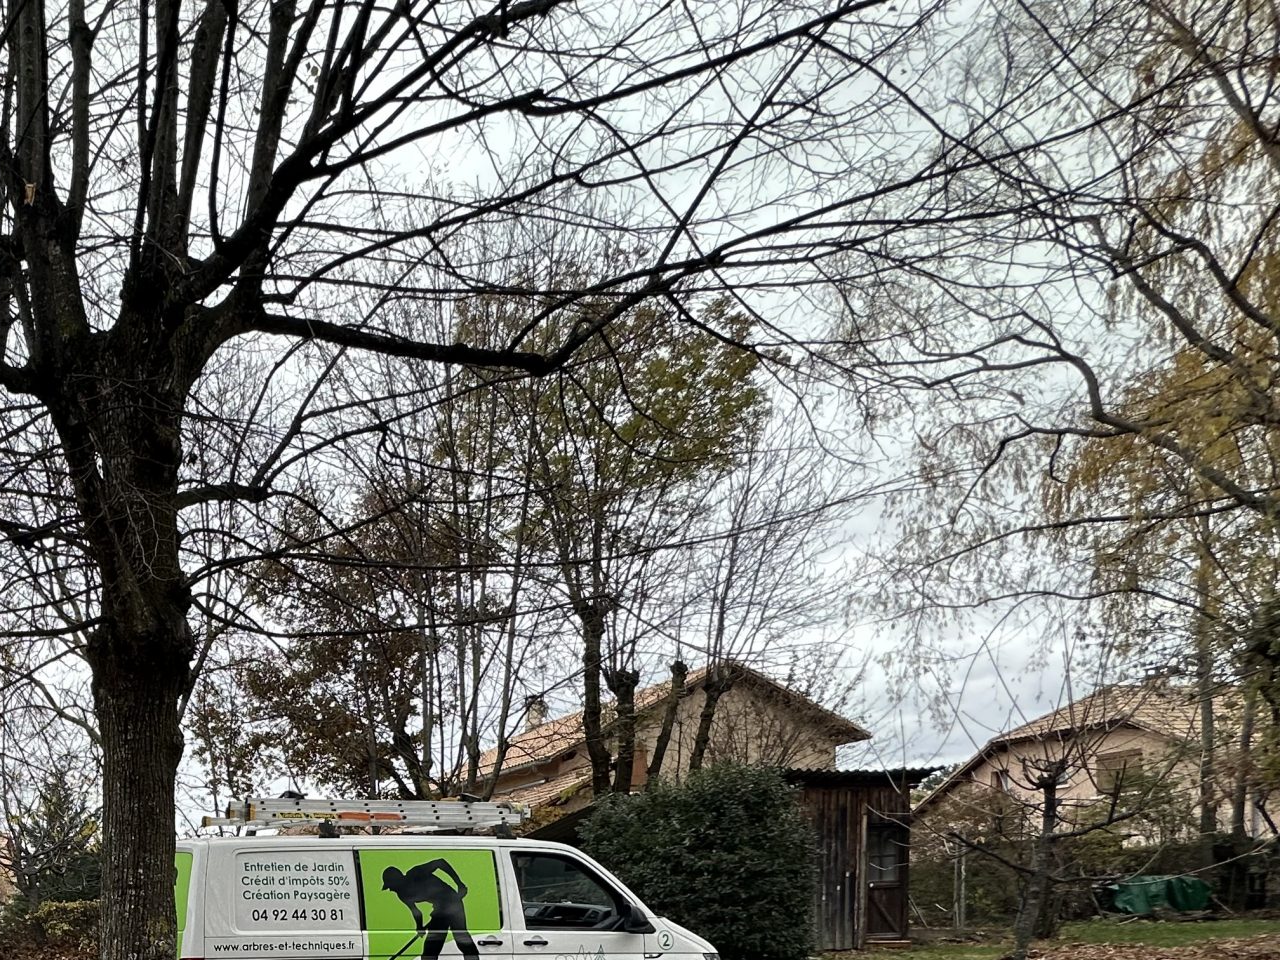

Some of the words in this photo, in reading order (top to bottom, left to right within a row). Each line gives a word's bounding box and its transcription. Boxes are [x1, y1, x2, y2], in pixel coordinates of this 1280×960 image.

[244, 862, 291, 872] Entretien
[294, 862, 309, 872] de
[312, 862, 344, 872] Jardin
[241, 875, 275, 886] Crédit
[278, 875, 325, 888] d'impôts
[328, 876, 350, 886] 50%
[242, 889, 290, 900] Création
[293, 889, 351, 902] Paysagère
[252, 909, 268, 921] 04
[272, 909, 288, 921] 92
[291, 909, 308, 921] 44
[311, 909, 326, 921] 30
[330, 909, 344, 921] 81
[213, 940, 355, 952] www.arbres-et-techniques.fr
[662, 934, 670, 946] 2
